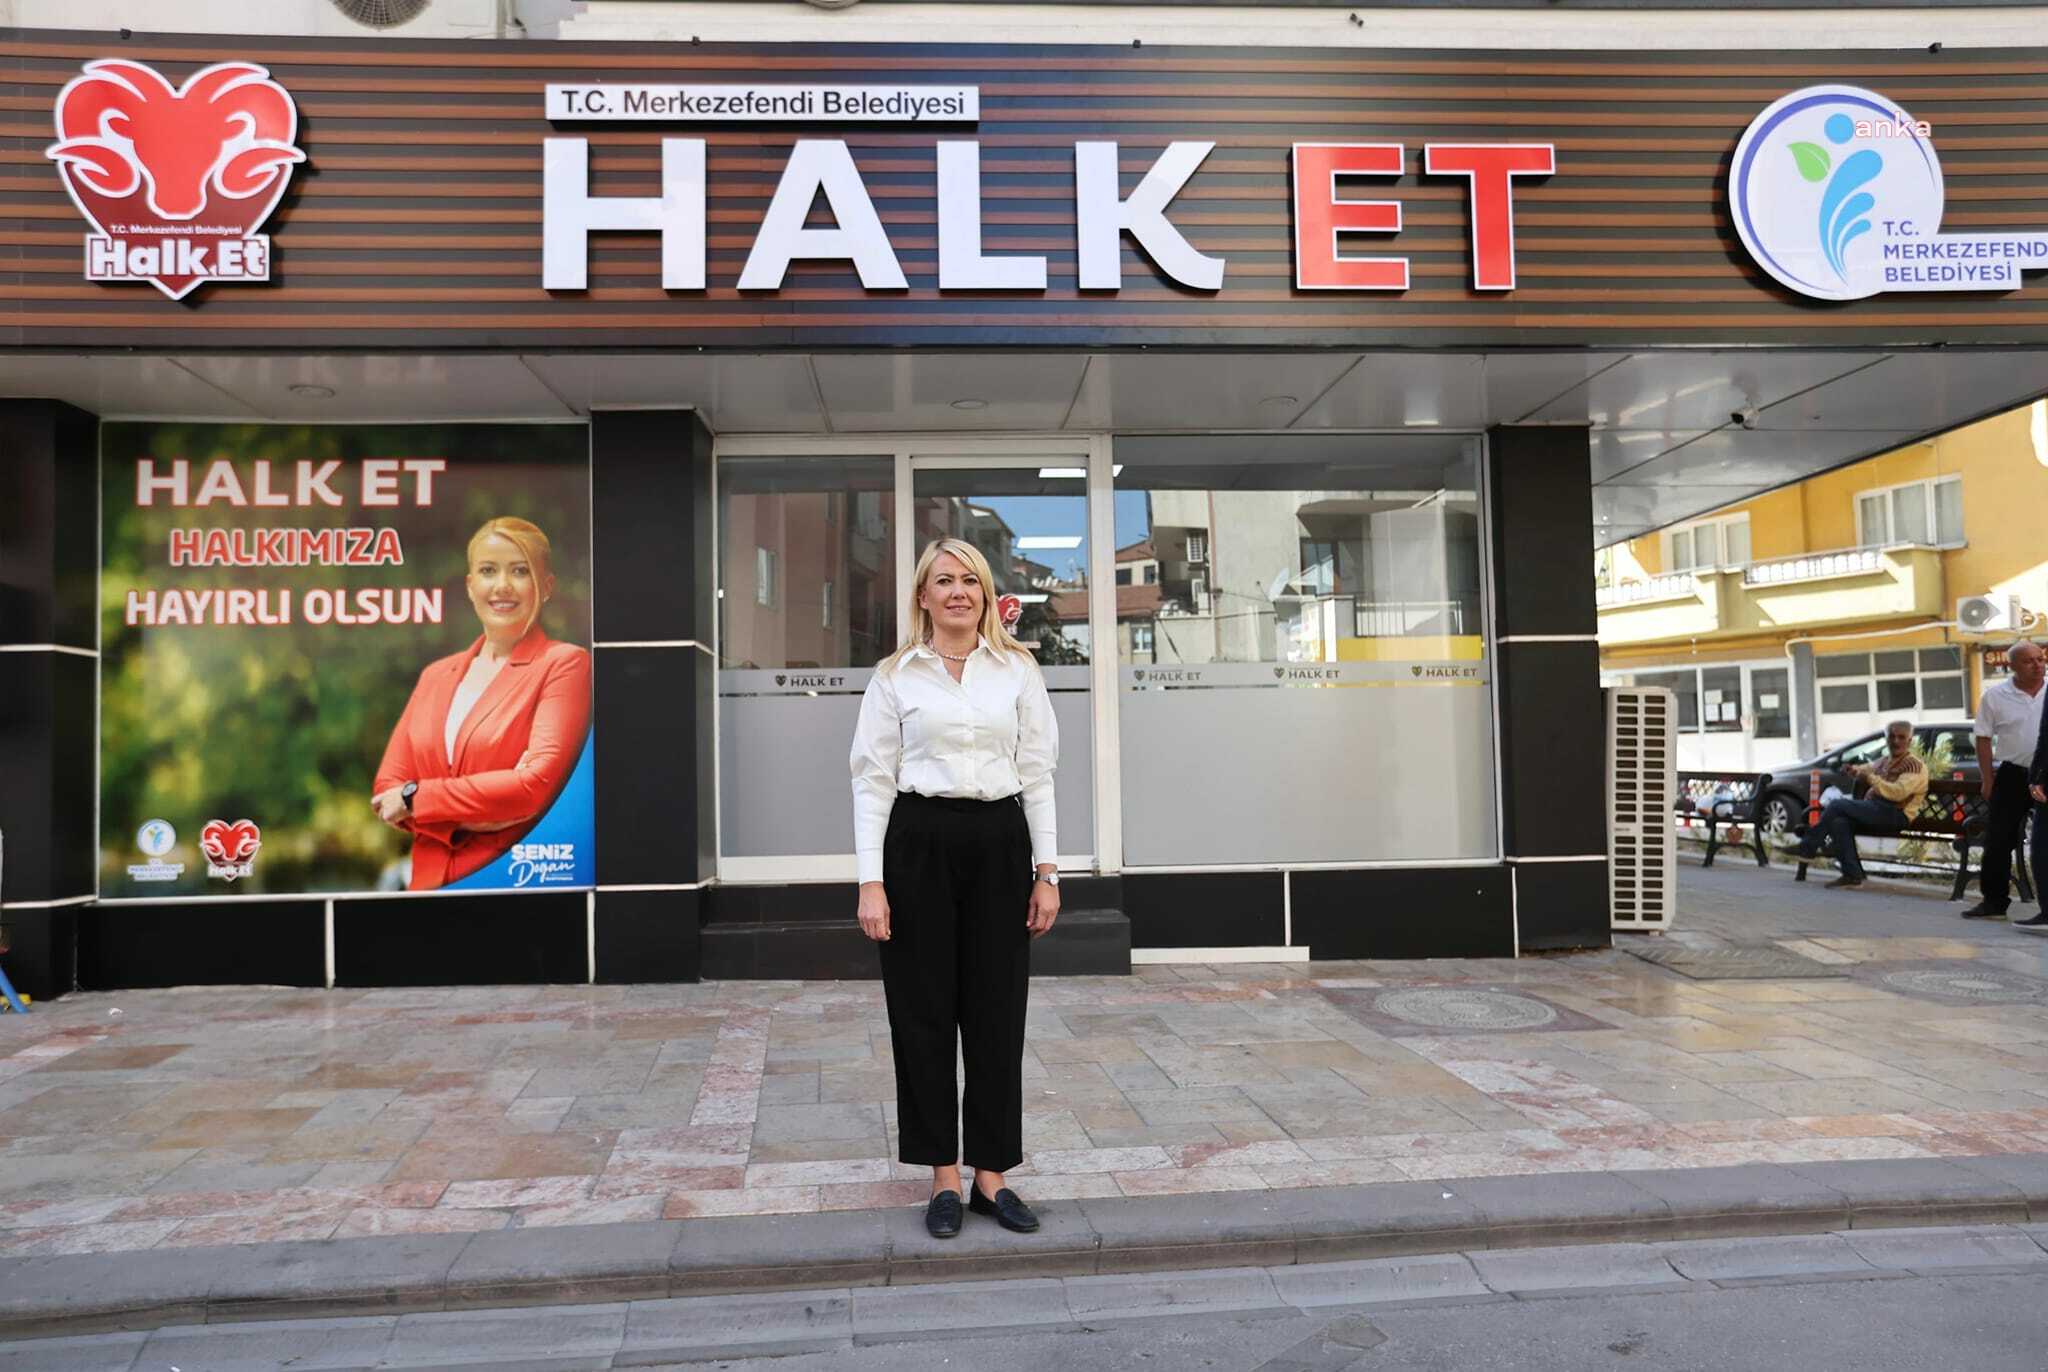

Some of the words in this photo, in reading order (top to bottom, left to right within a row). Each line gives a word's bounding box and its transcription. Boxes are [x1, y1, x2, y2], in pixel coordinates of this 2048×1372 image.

[560, 89, 614, 114] T.C.
[622, 90, 813, 115] Merkezefendi
[822, 91, 965, 121] Belediyesi
[543, 137, 1226, 291] HALK
[1291, 142, 1556, 291] ET
[110, 224, 129, 234] T.C.
[130, 224, 194, 235] Merkezefendi
[195, 225, 243, 236] Belediyesi
[1882, 220, 1920, 237] T.C.
[1884, 261, 2013, 283] BELEDİYESİ
[136, 458, 344, 507] HALK
[361, 458, 447, 507] ET
[169, 527, 404, 566] HALKIMIZA
[125, 588, 291, 626] HAYIRLI
[303, 587, 444, 625] OLSUN
[1150, 672, 1183, 681] HALK
[1187, 671, 1202, 681] ET
[1288, 669, 1322, 679] HALK
[1326, 669, 1341, 679] ET
[1426, 668, 1458, 677] HALK
[1464, 667, 1478, 676] ET
[791, 677, 826, 687] HALK
[830, 677, 844, 686] ET
